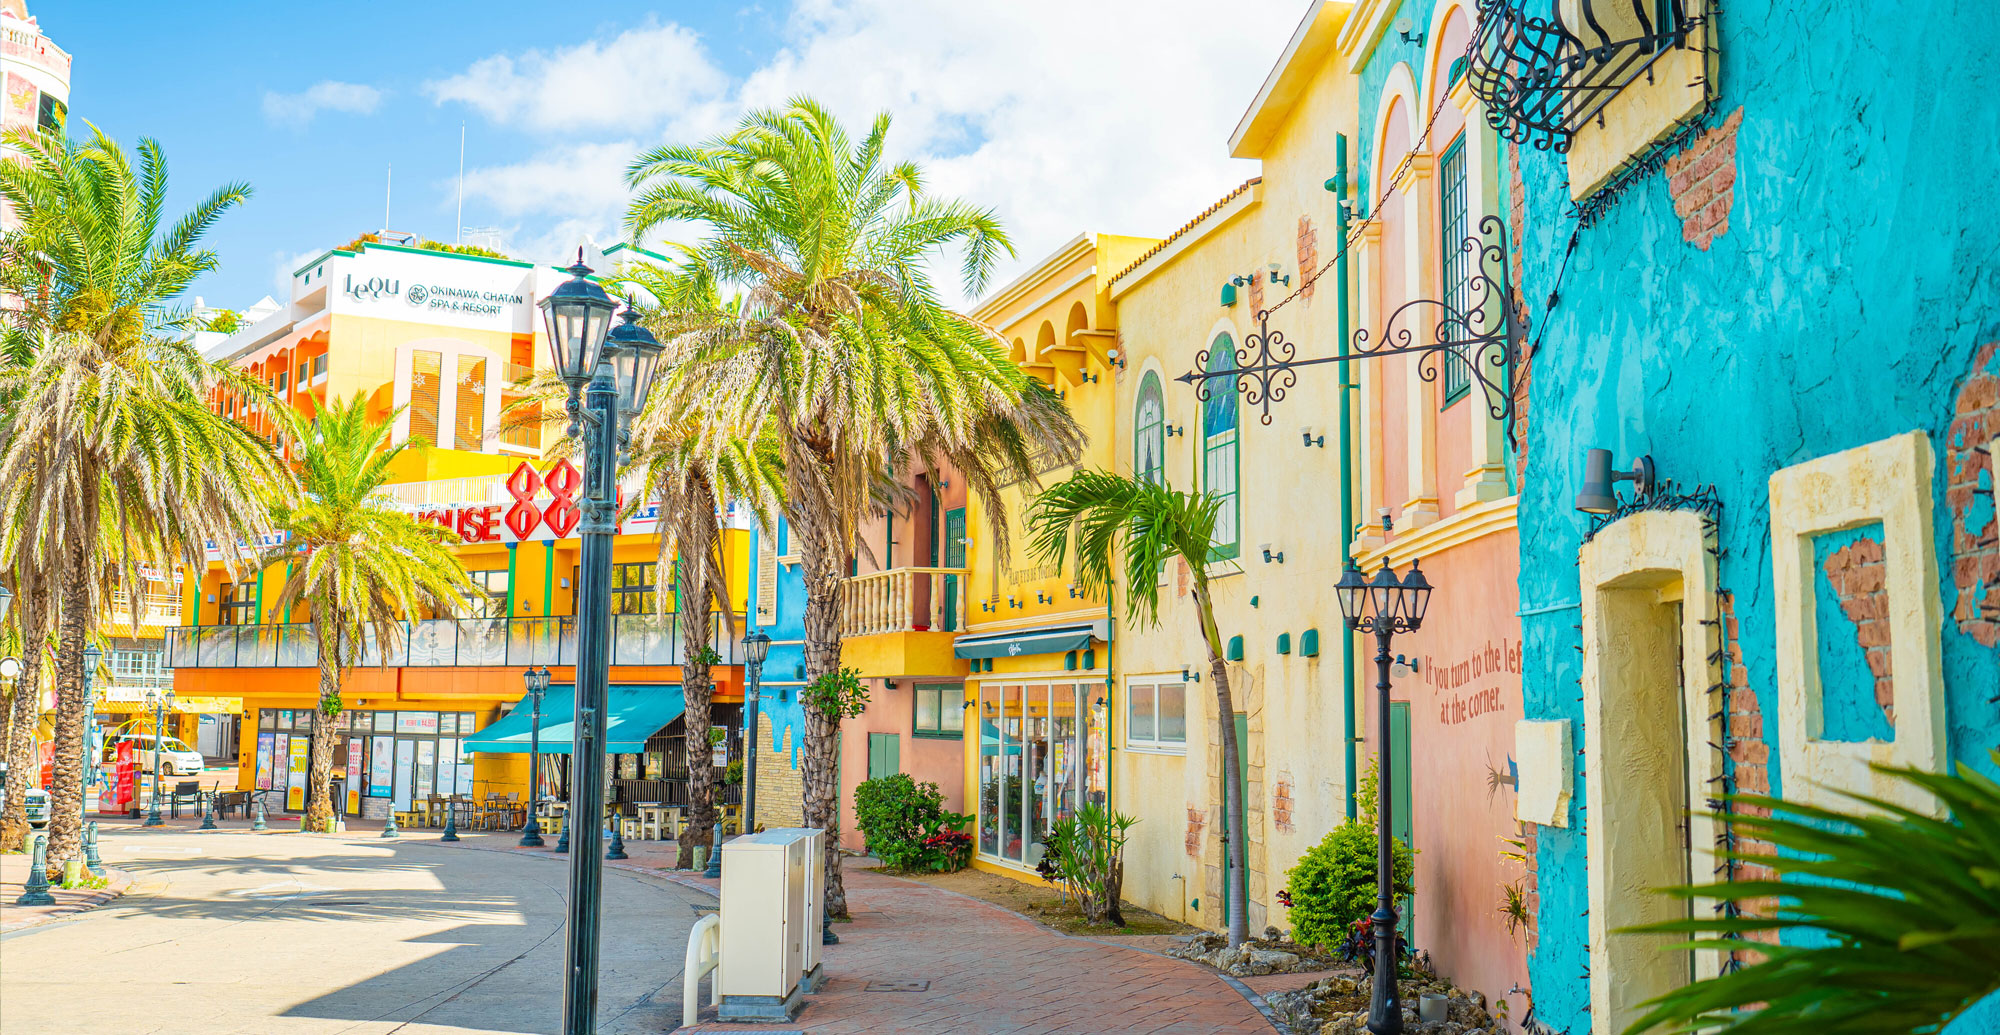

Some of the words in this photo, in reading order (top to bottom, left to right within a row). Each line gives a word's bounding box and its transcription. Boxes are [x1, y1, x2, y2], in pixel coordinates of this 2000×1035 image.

[430, 285, 480, 300] OKINAWA
[483, 291, 523, 305] CHATAN
[430, 298, 450, 309] SPA
[452, 301, 460, 310] &
[462, 302, 502, 315] RESORT
[504, 457, 583, 541] 88
[1425, 655, 1432, 685] If
[1434, 666, 1449, 696] you
[1450, 660, 1470, 689] turn
[1472, 650, 1482, 679] to
[1484, 640, 1501, 674] the
[1440, 698, 1449, 725] at
[1451, 693, 1467, 725] the
